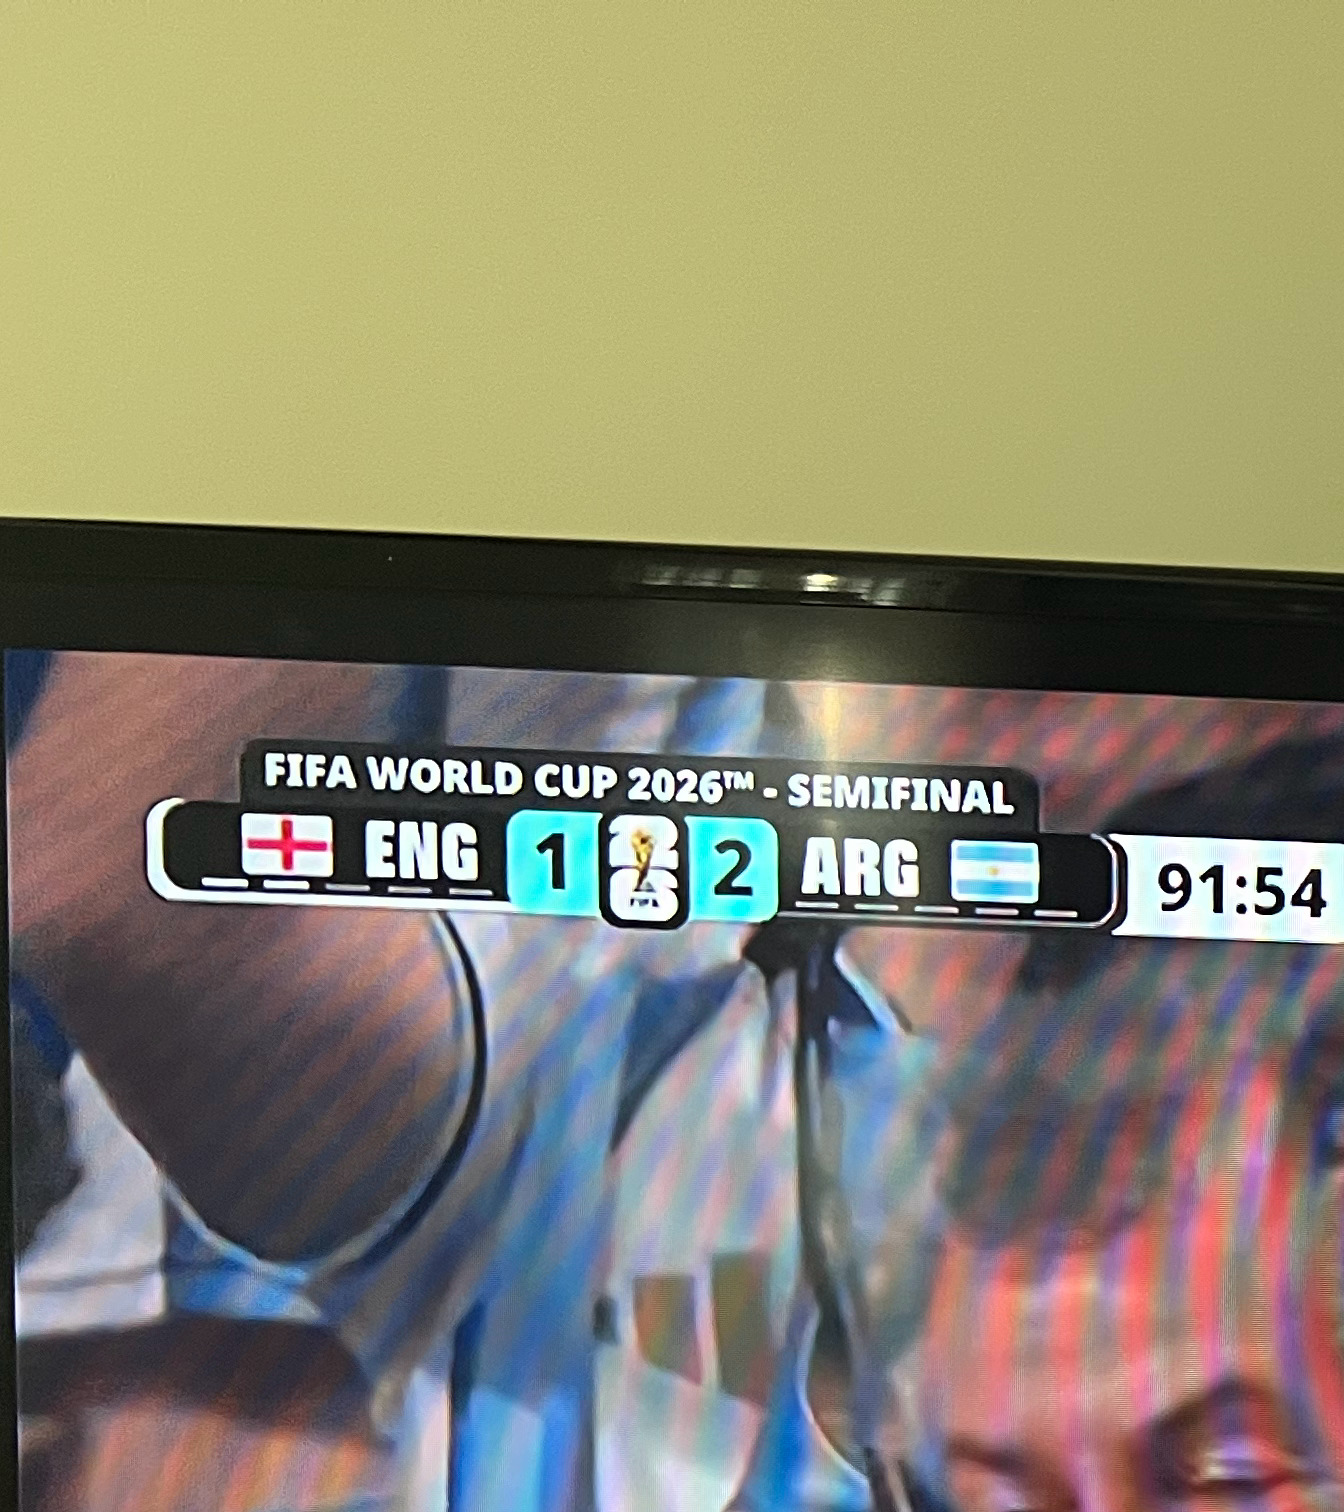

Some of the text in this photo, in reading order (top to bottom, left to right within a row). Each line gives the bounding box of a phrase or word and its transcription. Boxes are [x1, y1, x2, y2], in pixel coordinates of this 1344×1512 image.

[264, 753, 357, 789] FIFA
[366, 756, 524, 795] WORLD
[534, 763, 618, 799] CUP
[763, 787, 778, 798] -
[787, 773, 1014, 815] SEMIFINAL
[366, 819, 478, 881] ENG
[537, 832, 565, 890] 1
[714, 839, 753, 896] 2
[802, 837, 921, 898] ARG
[1157, 863, 1328, 918] 91:54
